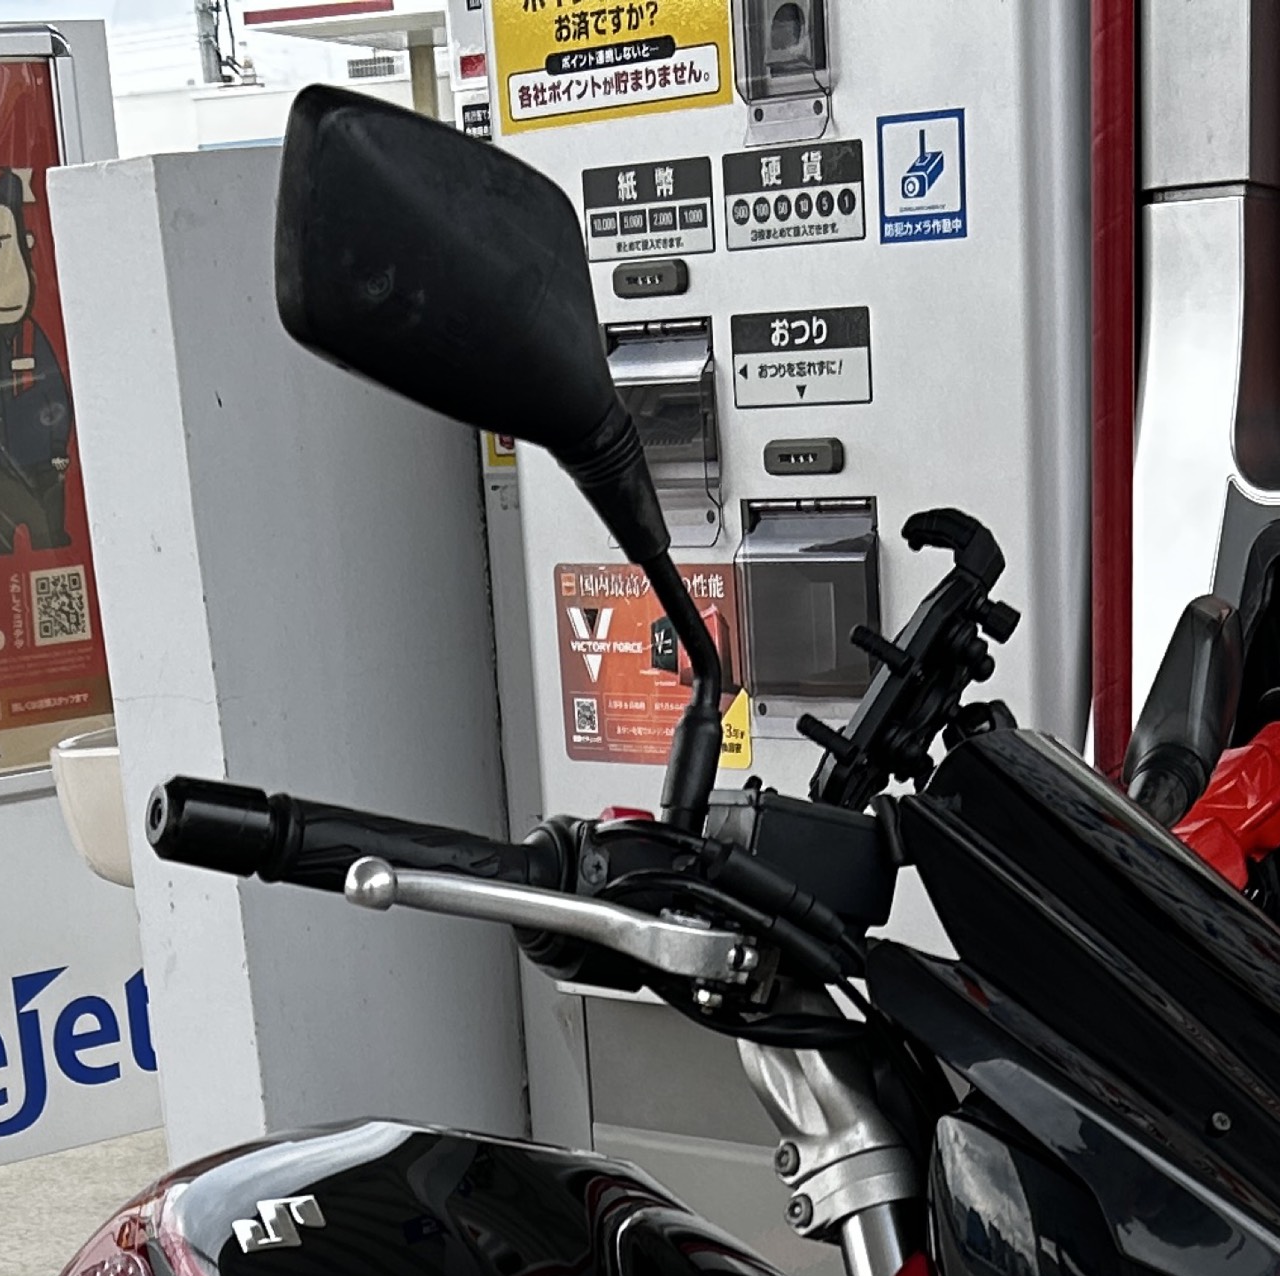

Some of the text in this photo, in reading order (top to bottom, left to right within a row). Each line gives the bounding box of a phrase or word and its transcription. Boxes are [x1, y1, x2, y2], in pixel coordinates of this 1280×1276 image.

[555, 4, 659, 42] お済ですか?
[518, 61, 711, 109] 各社ポイントが貯まりません。
[884, 218, 963, 238] 防犯カメラ作動中
[770, 315, 828, 347] おつり
[570, 640, 643, 653] VICTORY FORCE
